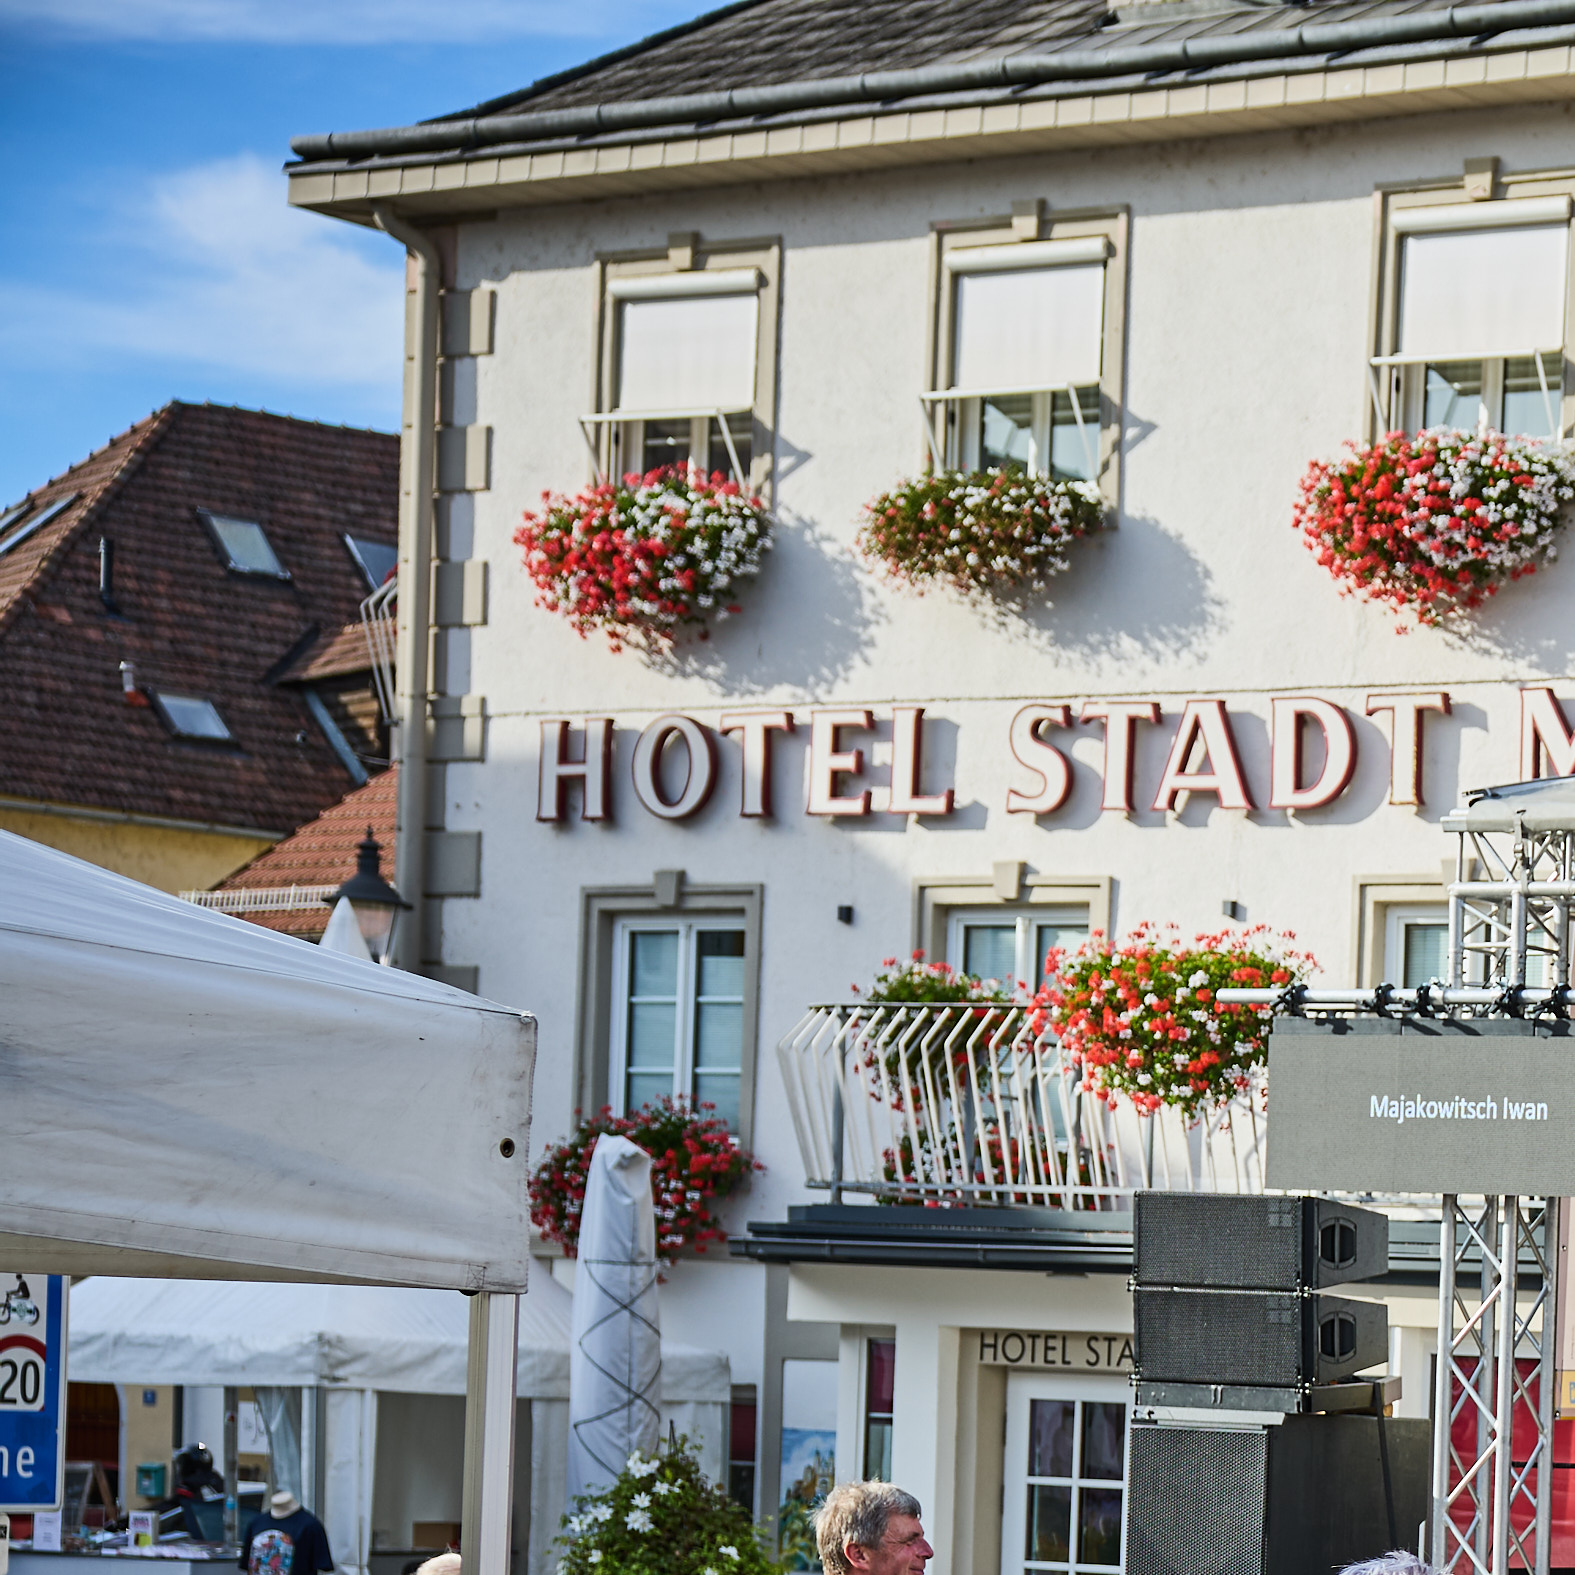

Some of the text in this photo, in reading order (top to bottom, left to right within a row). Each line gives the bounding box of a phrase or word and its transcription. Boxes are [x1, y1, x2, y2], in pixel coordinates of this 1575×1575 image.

[536, 707, 953, 823] HOTEL
[1005, 691, 1451, 814] STADT
[1369, 1094, 1549, 1126] Majakowitsch Iwan
[979, 1331, 1071, 1366] HOTEL
